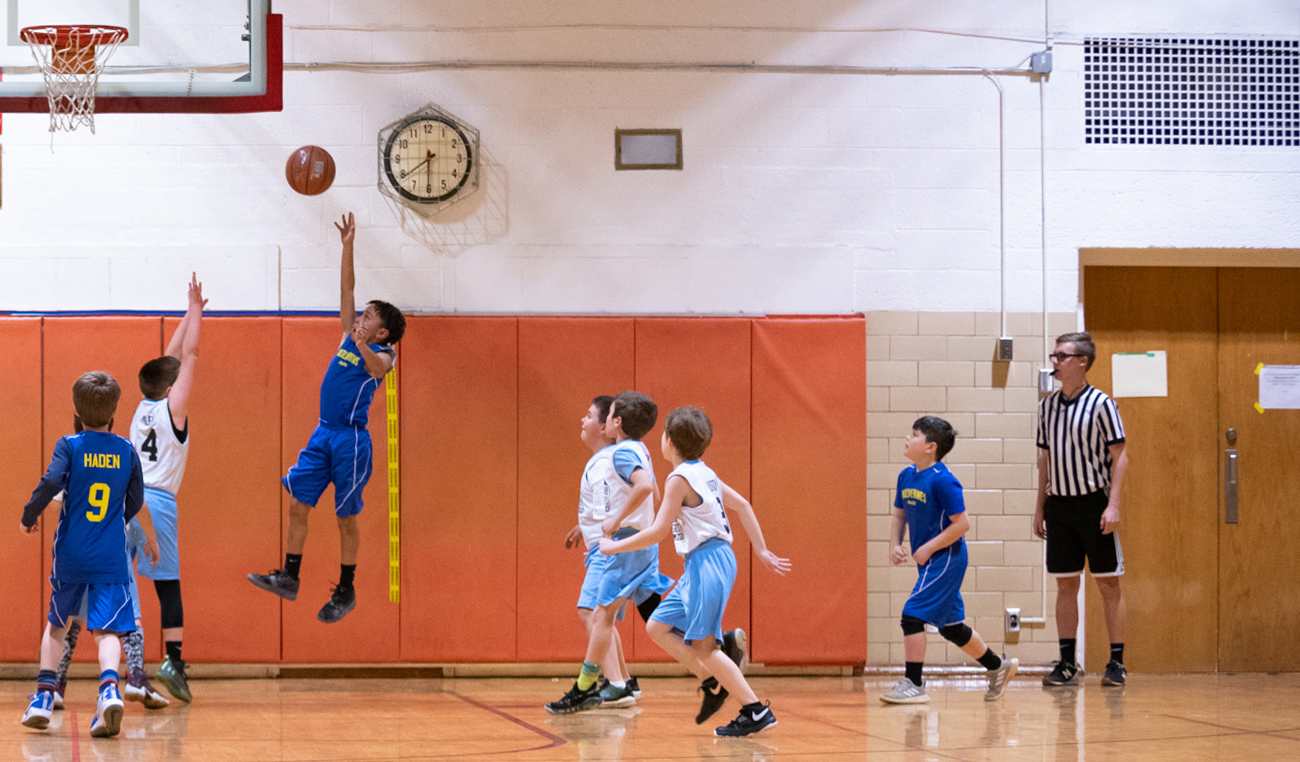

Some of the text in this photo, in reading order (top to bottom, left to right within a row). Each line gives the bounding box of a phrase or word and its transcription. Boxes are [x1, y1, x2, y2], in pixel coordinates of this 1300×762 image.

[409, 129, 418, 138] 11
[423, 124, 433, 134] 12
[399, 139, 409, 149] 10
[451, 139, 457, 149] 2
[395, 154, 401, 164] 9
[457, 154, 462, 164] 3
[400, 169, 406, 179] 8
[451, 168, 457, 178] 4
[411, 180, 417, 190] 7
[426, 184, 432, 194] 6
[441, 180, 447, 190] 5
[141, 428, 158, 462] 4
[84, 453, 120, 469] HADEN
[86, 482, 111, 523] 9
